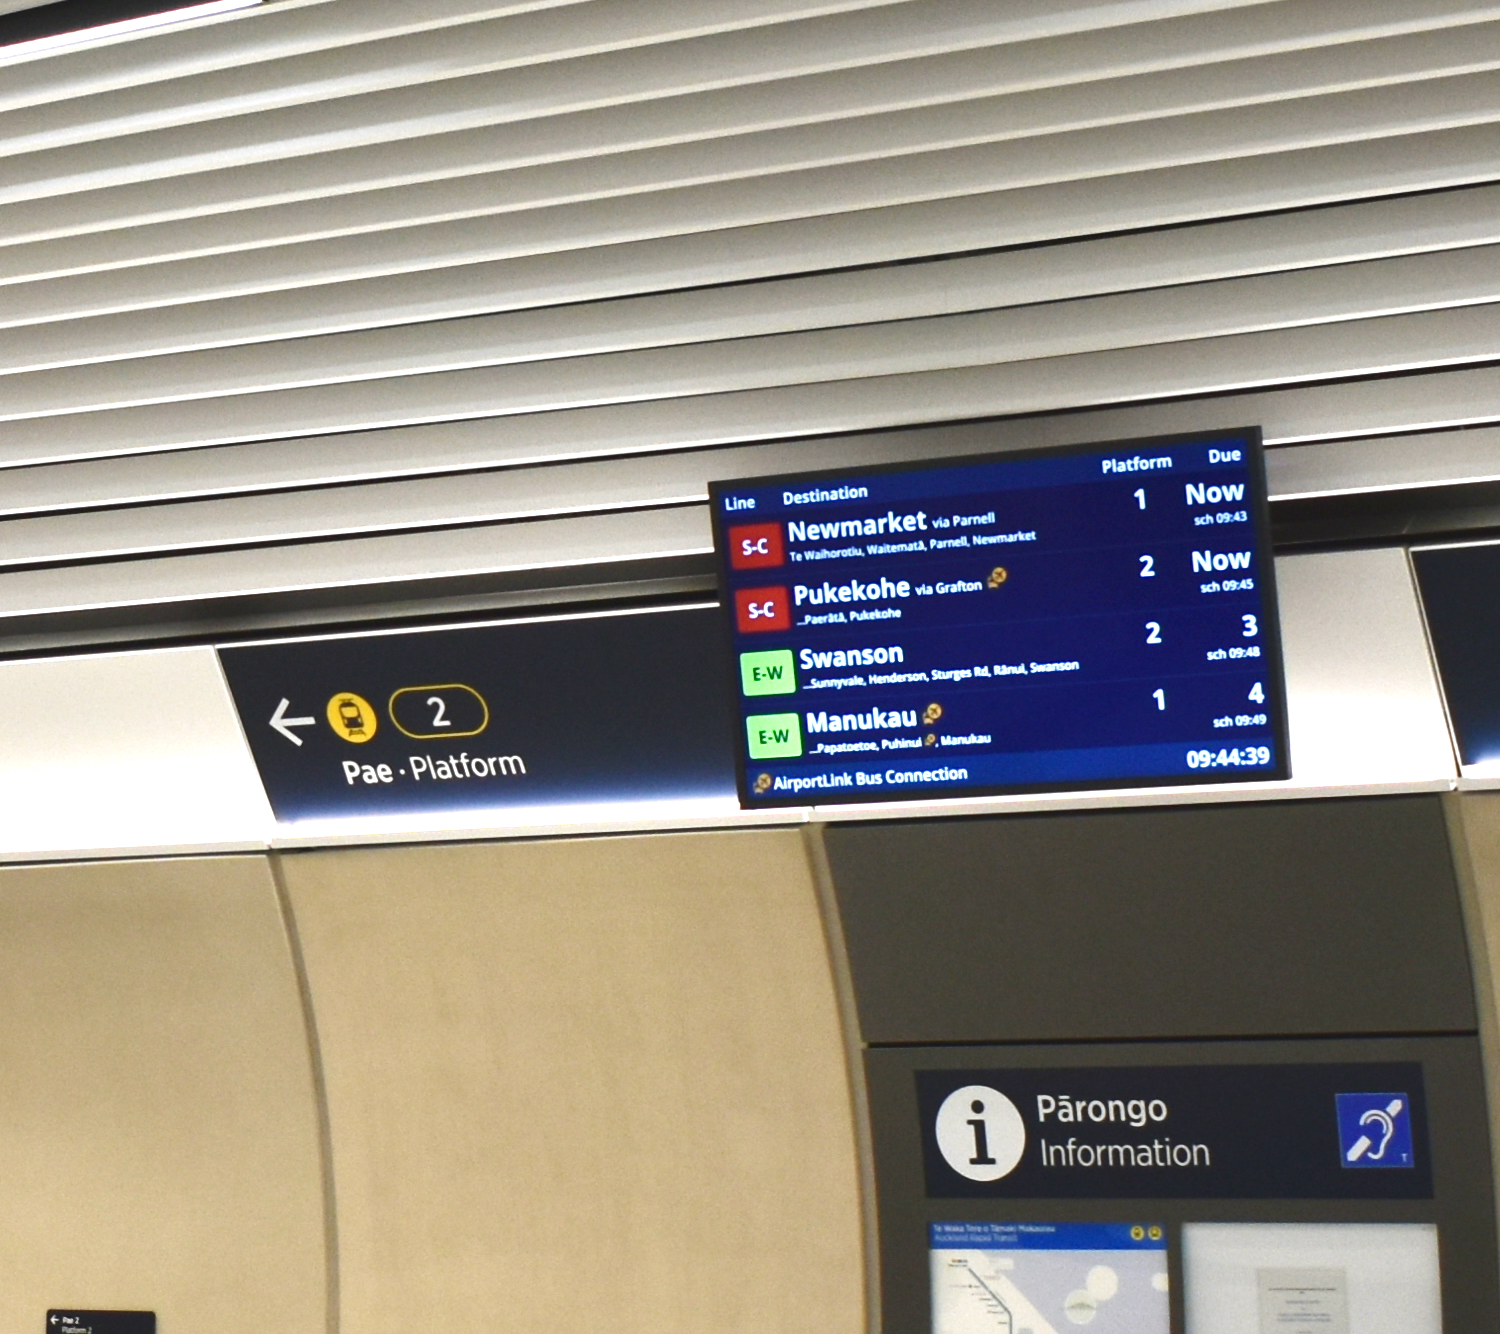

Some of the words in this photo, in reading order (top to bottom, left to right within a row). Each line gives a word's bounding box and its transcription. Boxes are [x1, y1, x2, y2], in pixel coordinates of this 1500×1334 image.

[725, 496, 756, 511] Line
[783, 485, 868, 506] Destination
[1101, 455, 1173, 474] Platform
[1208, 449, 1242, 464] Due
[741, 537, 769, 557] S-C
[787, 510, 928, 543] Newmarket
[932, 517, 950, 529] via
[952, 511, 996, 527] Parnell
[1133, 488, 1147, 510] 1
[1185, 483, 1245, 506] Now
[790, 550, 802, 562] Te
[929, 536, 970, 551] Parnell,
[972, 529, 1037, 546] Newmarket
[1193, 514, 1214, 526] sch
[1216, 510, 1248, 524] 09:43
[747, 601, 775, 620] S-C
[793, 576, 911, 606] Pukekohe
[915, 584, 933, 597] via
[935, 579, 983, 595] Grafton
[1138, 554, 1156, 577] 2
[1191, 550, 1251, 573] Now
[849, 607, 902, 623] Pukekohe
[1200, 581, 1220, 593] sch
[1222, 578, 1254, 591] 09:45
[752, 664, 784, 682] E-W
[799, 644, 904, 670] Swanson
[1145, 621, 1162, 645] 2
[1241, 613, 1259, 638] 3
[868, 669, 930, 685] Henderson,
[931, 666, 972, 682] Sturges
[974, 665, 992, 680] Rd,
[1029, 658, 1080, 674] Swanson
[1206, 648, 1227, 661] sch
[1228, 645, 1260, 659] 09:48
[426, 696, 452, 727] 2
[758, 728, 790, 745] E-W
[806, 706, 918, 734] Manukau
[1152, 688, 1166, 711] 1
[1247, 681, 1265, 705] 4
[881, 735, 922, 750] Puhinui
[940, 732, 992, 747] Manukau
[1212, 715, 1234, 728] sch
[1235, 713, 1267, 727] 09:49
[341, 759, 394, 786] Pae
[409, 750, 527, 781] Platform
[773, 770, 853, 792] AirportLink
[855, 770, 883, 786] Bus
[885, 766, 968, 784] Connection
[1186, 745, 1271, 769] 09:44:39
[1036, 1094, 1168, 1128] Pārongo
[1040, 1138, 1211, 1167] Information
